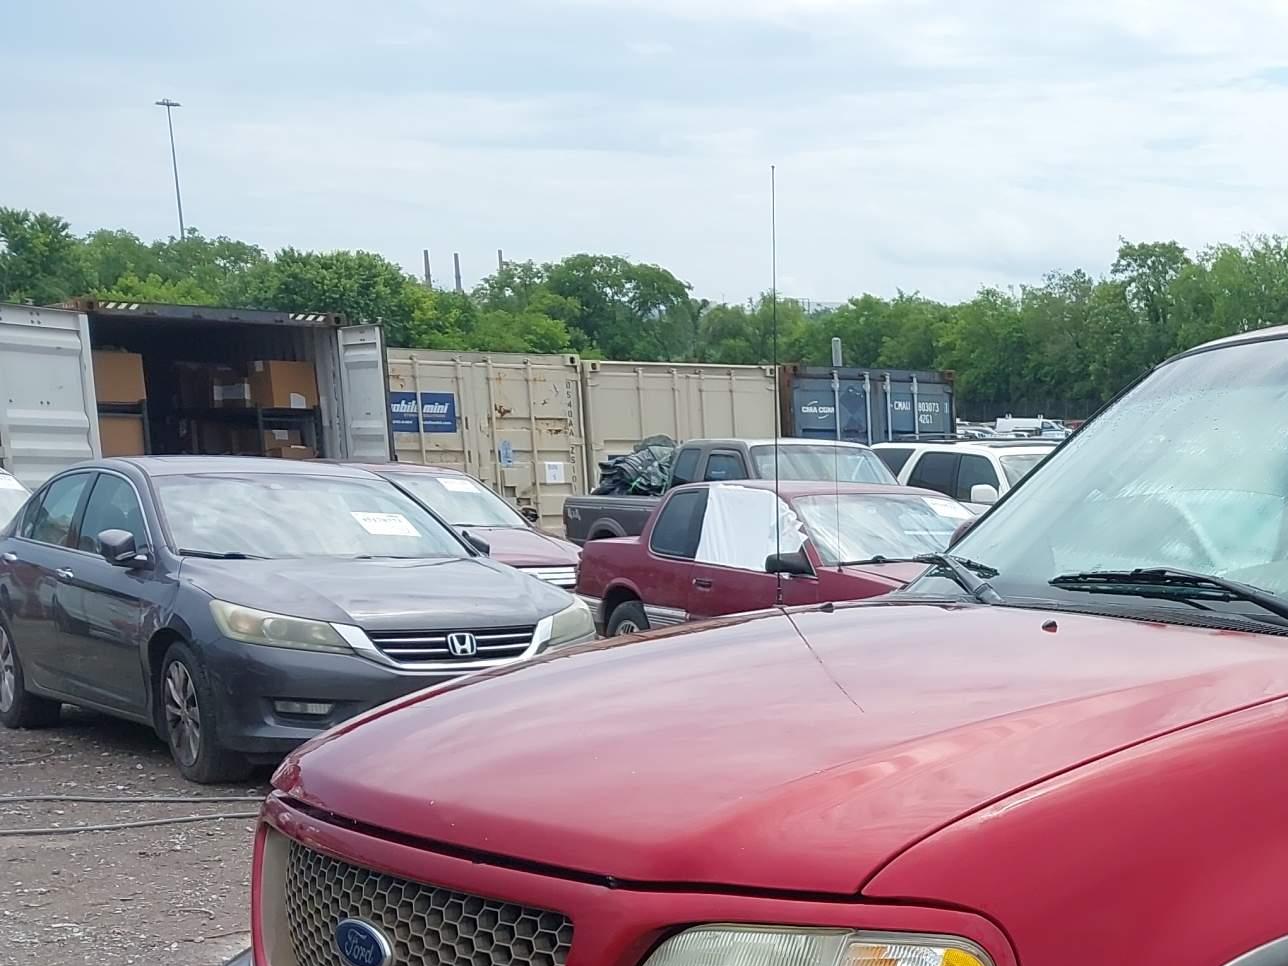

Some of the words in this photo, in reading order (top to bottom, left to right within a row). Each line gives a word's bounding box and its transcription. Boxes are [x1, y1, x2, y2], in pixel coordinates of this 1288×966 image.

[391, 400, 417, 413] obil
[423, 402, 449, 414] mini
[801, 405, 818, 413] CMA
[344, 928, 375, 964] Ford
